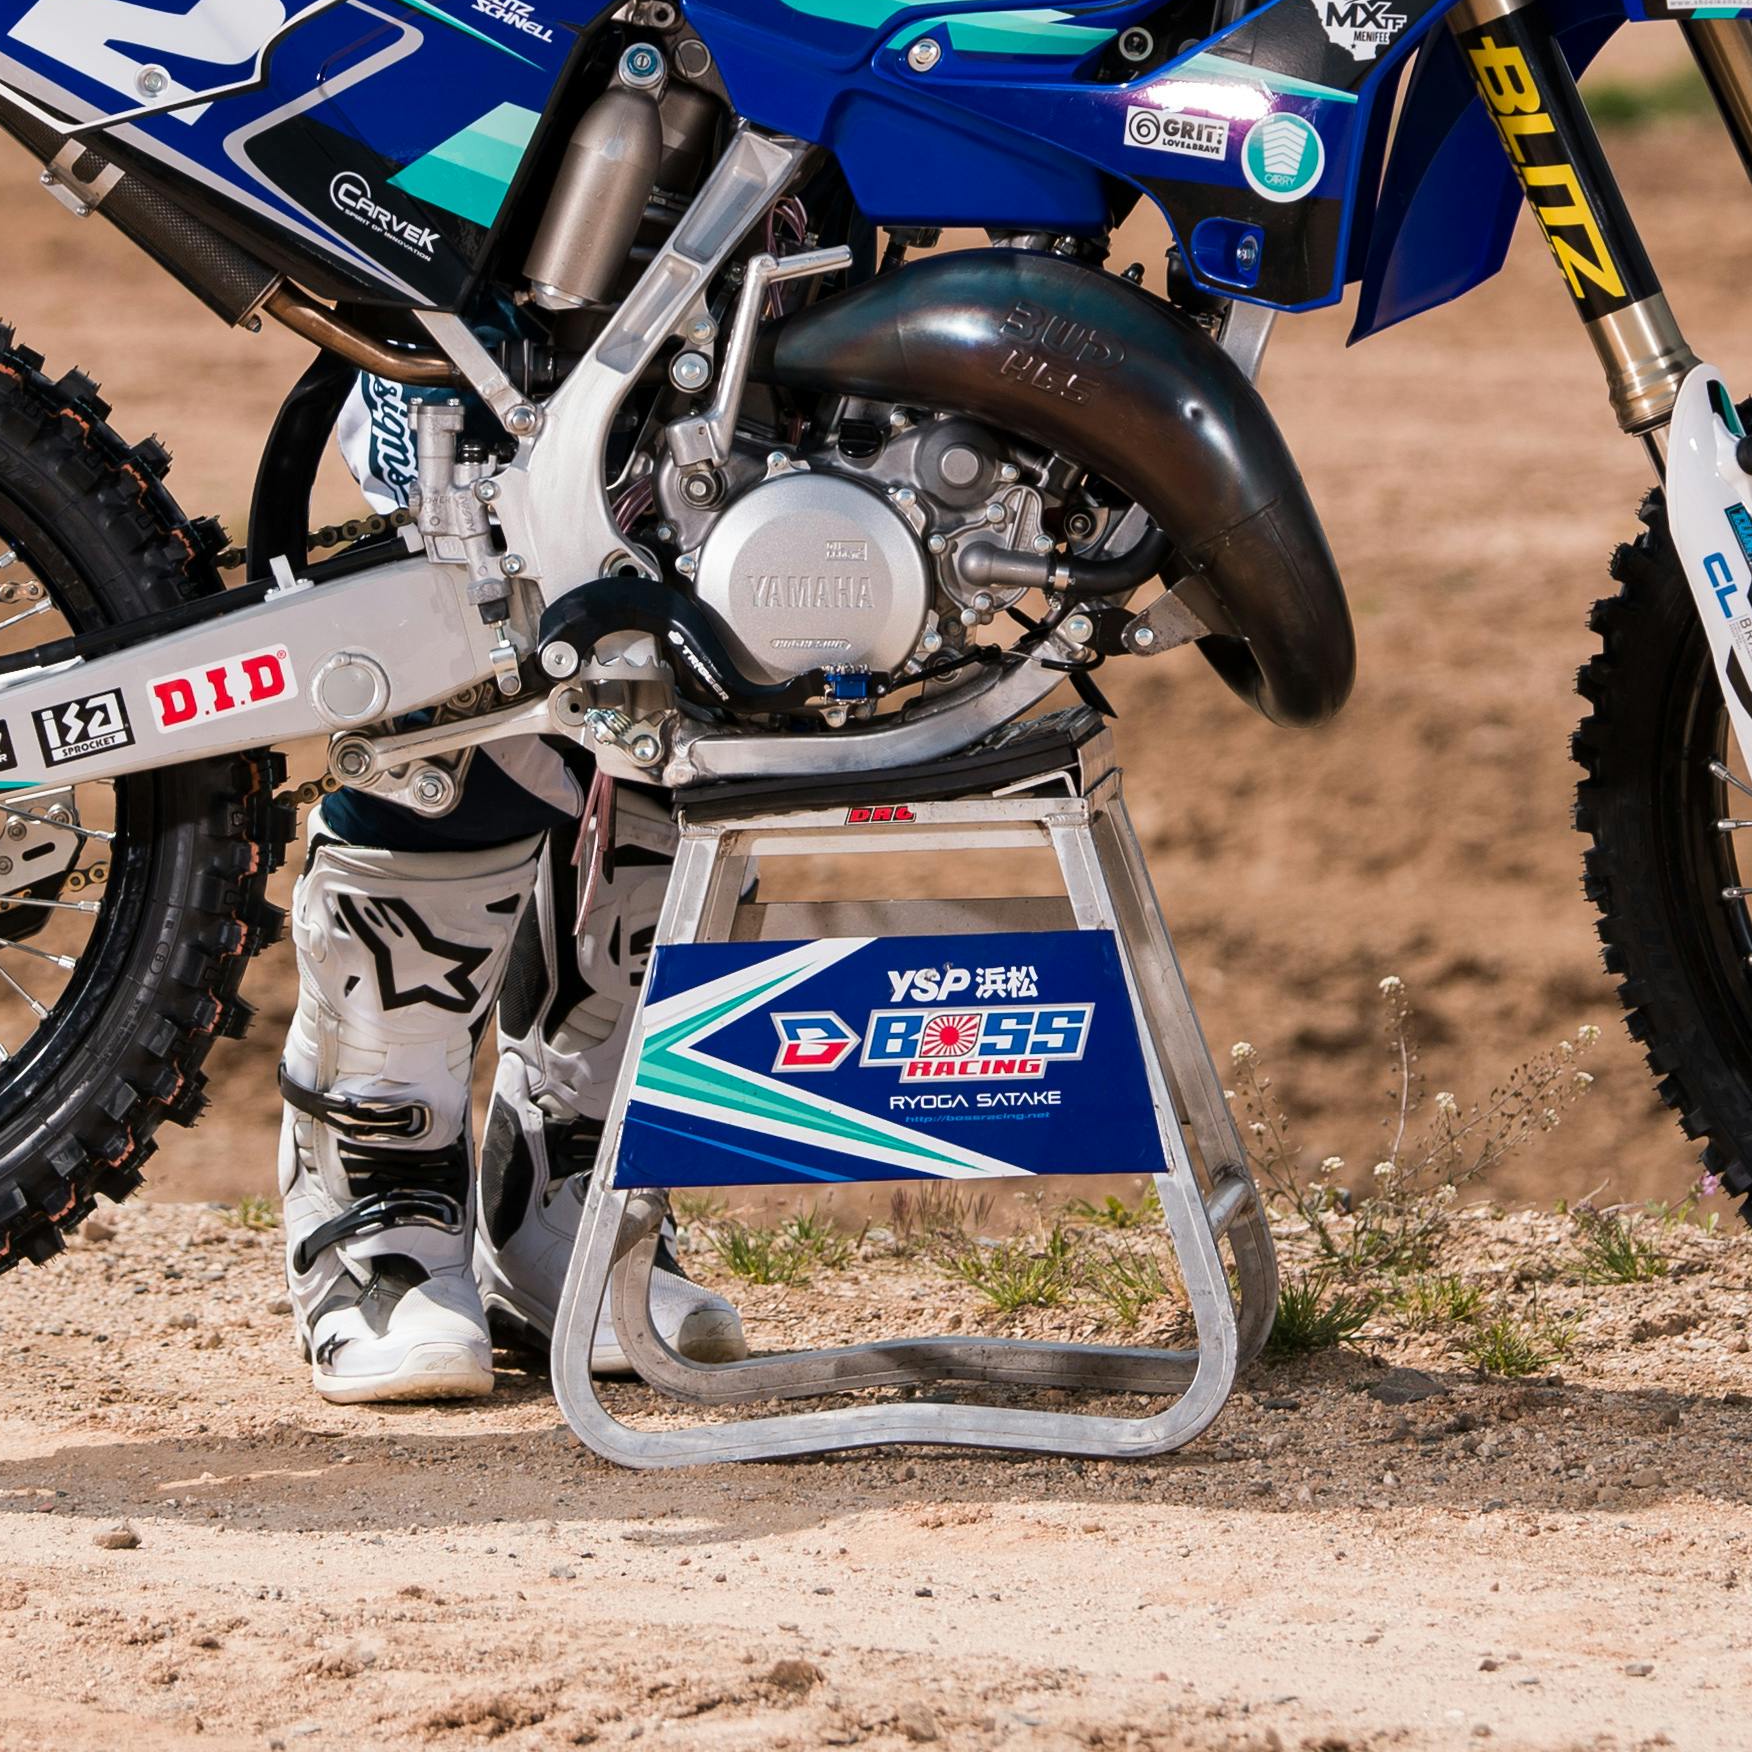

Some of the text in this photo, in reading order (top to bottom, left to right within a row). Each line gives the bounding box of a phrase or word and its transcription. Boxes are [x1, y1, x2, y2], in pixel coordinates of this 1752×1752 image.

[1326, 1, 1390, 29] MX
[1353, 30, 1389, 43] MENIFEE
[1162, 137, 1221, 155] LOVE&BRAVE
[1264, 172, 1297, 187] CARRY
[1468, 36, 1627, 299] BLITZ
[336, 181, 441, 254] CARVEK
[746, 575, 876, 609] YAMAHA
[1702, 551, 1739, 618] CL
[154, 651, 286, 728] D.I.D
[61, 734, 117, 758] SPROCKET
[888, 965, 1040, 1003] YSP 浜松
[867, 1009, 1088, 1061] BOSS
[906, 1057, 1042, 1078] RACING
[889, 1089, 1063, 1111] RYOGA SATAKE
